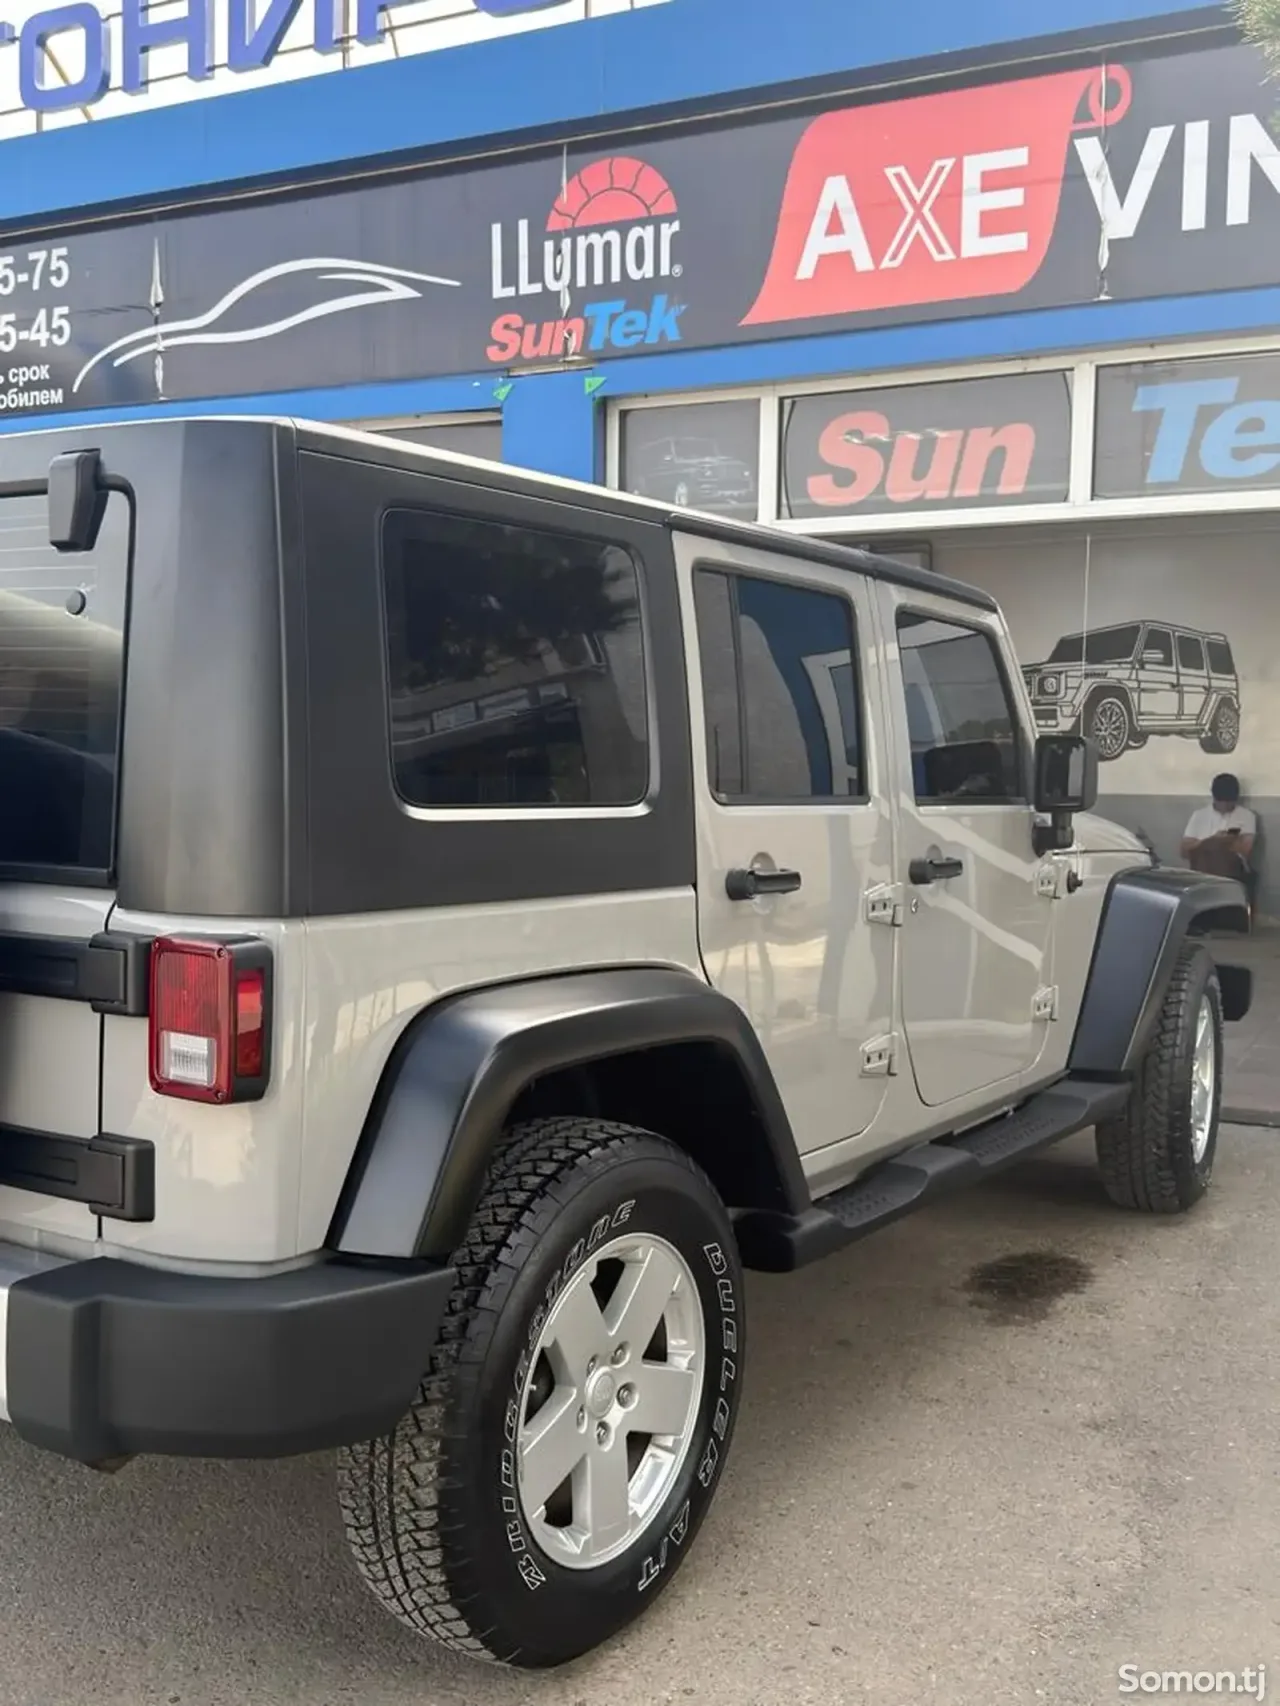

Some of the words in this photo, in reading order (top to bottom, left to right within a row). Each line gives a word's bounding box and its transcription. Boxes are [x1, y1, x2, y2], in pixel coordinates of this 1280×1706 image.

[795, 147, 1029, 280] AXE
[8, 364, 50, 387] срок
[806, 411, 1036, 506] Sun
[698, 1243, 738, 1487] DUELER
[638, 1499, 690, 1591] A/T
